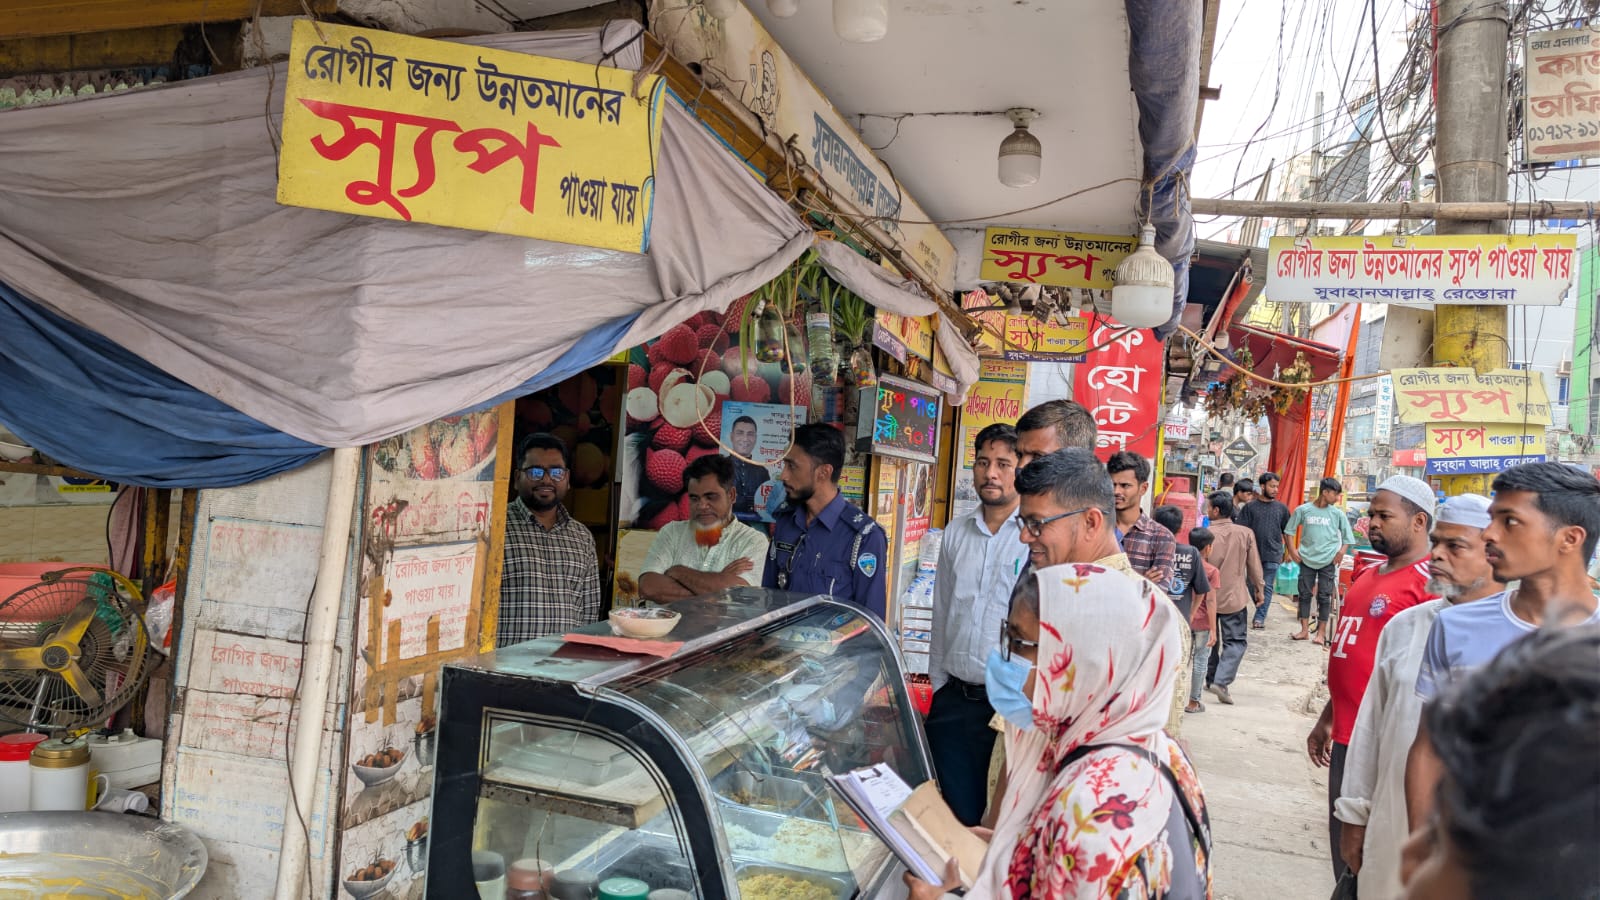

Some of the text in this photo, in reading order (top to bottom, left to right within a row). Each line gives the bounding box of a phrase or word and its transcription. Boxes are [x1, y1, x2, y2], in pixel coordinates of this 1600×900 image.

[304, 35, 625, 125] রোগীর জন্য উন্নতমানের
[296, 98, 562, 222] স্যুপ
[560, 172, 639, 226] পাওয়া যায়
[991, 230, 1132, 253] রোগীর জন্য উন্নতমানের
[989, 249, 1103, 283] স্যুপ
[1277, 239, 1573, 286] রোগীর জন্য উন্নতমানের স্যুপ পাওয়া যায়
[1008, 330, 1045, 349] স্যুপ
[1047, 338, 1066, 346] পাওয়া
[1400, 371, 1440, 385] রোগীর
[1445, 373, 1470, 385] জন্য
[966, 386, 991, 420] মহিলা
[992, 389, 1020, 422] কেবিন
[1400, 387, 1513, 420] স্যুপ
[1431, 424, 1487, 456] স্যুপ
[1488, 435, 1516, 446] পাওয়া
[1520, 436, 1536, 445] যায়
[432, 558, 454, 573] জন্য
[404, 586, 436, 606] পাওয়া
[437, 584, 456, 600] যায়
[260, 652, 289, 672] জন্য
